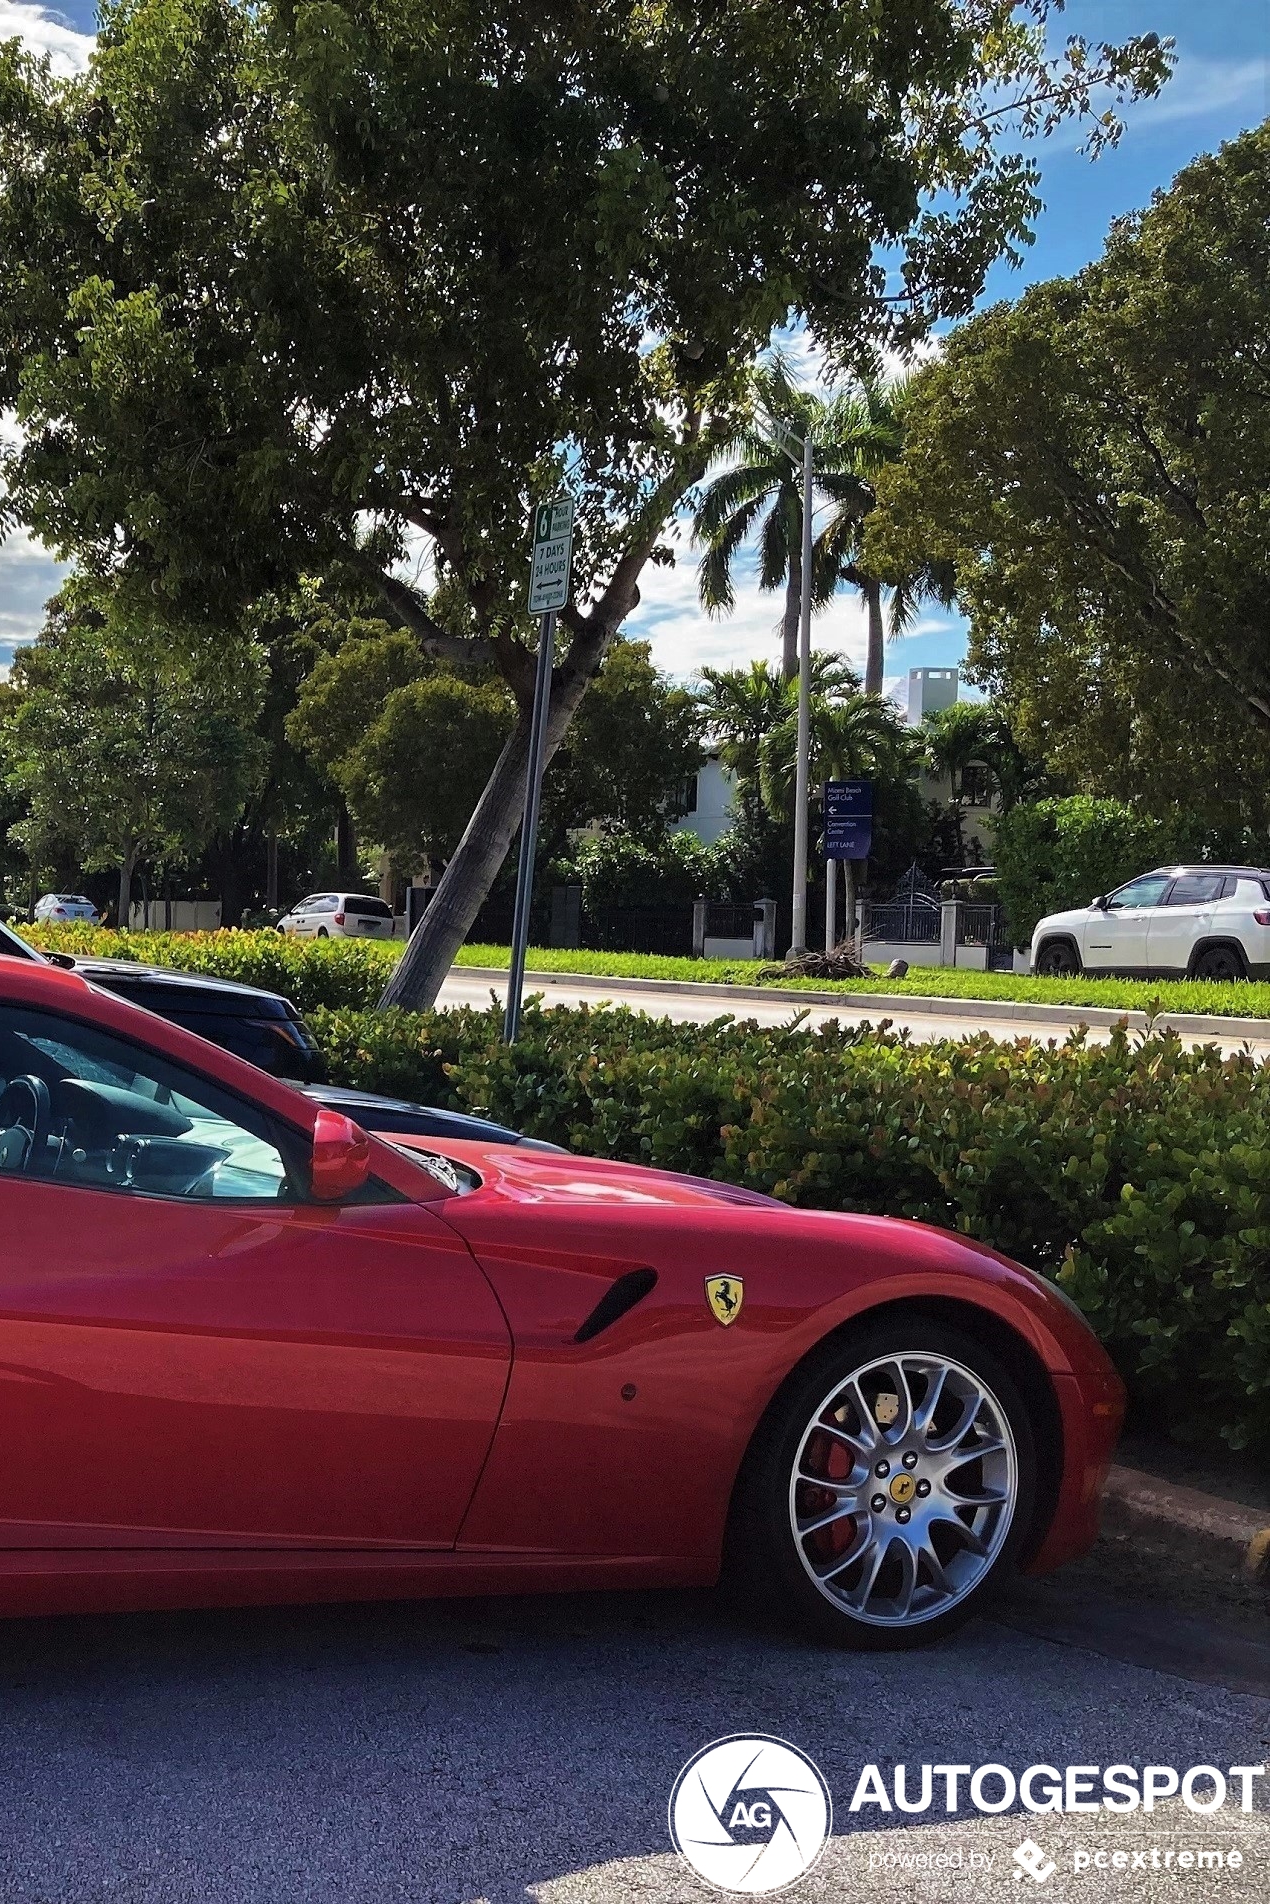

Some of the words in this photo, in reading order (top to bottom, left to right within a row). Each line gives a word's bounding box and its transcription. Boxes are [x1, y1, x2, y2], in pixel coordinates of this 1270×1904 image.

[539, 510, 548, 537] 6
[540, 548, 545, 560] 7
[546, 543, 564, 558] DAYS
[536, 565, 543, 577] 24
[544, 559, 566, 575] HOURS
[827, 820, 857, 828] Convention
